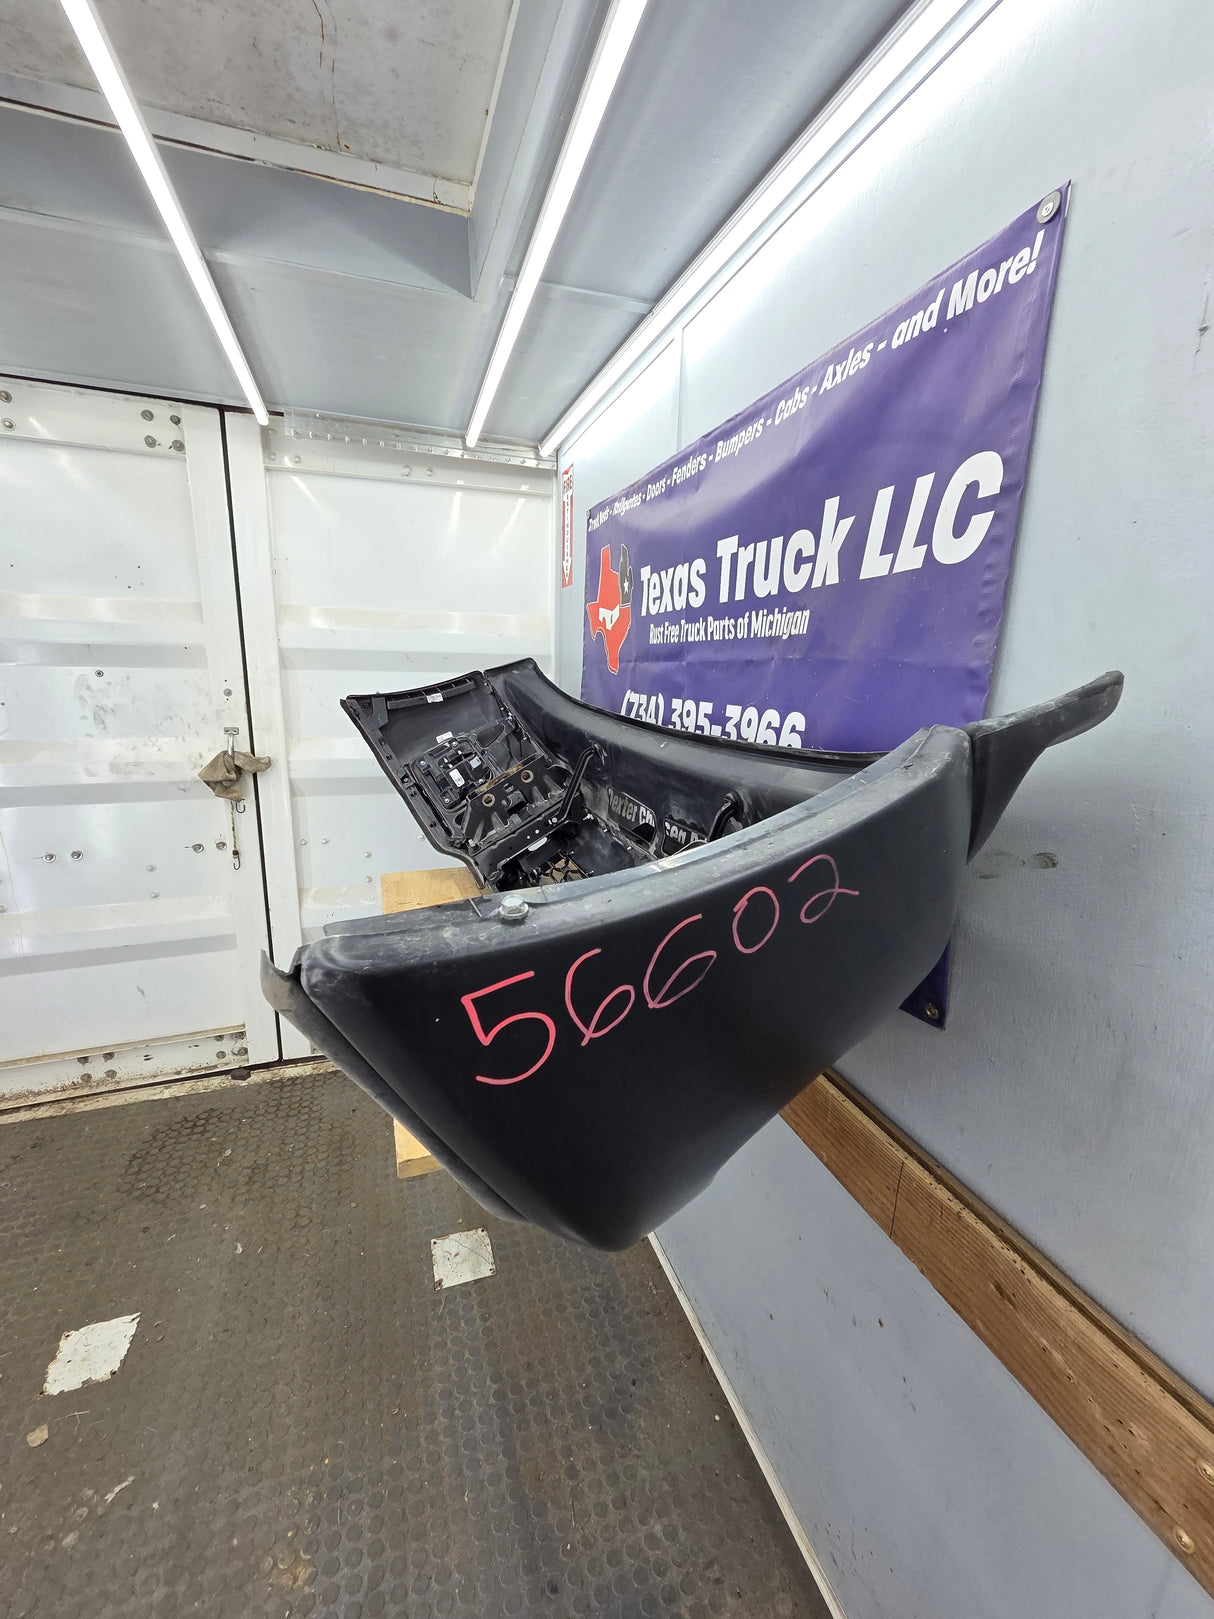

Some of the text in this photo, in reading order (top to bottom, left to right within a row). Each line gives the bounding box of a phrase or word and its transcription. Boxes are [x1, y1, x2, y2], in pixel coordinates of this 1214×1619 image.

[646, 478, 666, 502] Doors
[671, 453, 707, 486] Fenders
[715, 417, 764, 460] Bumpers
[775, 385, 809, 426] Cabs
[818, 342, 874, 396] Axles
[891, 287, 946, 349] and
[946, 229, 1045, 320] More!
[640, 450, 1004, 616] Texas Truck LLC
[649, 607, 810, 644] Rust Free Truck Parts of Michigan
[620, 689, 806, 748] (734) 395-3966
[461, 854, 859, 1086] 56602
